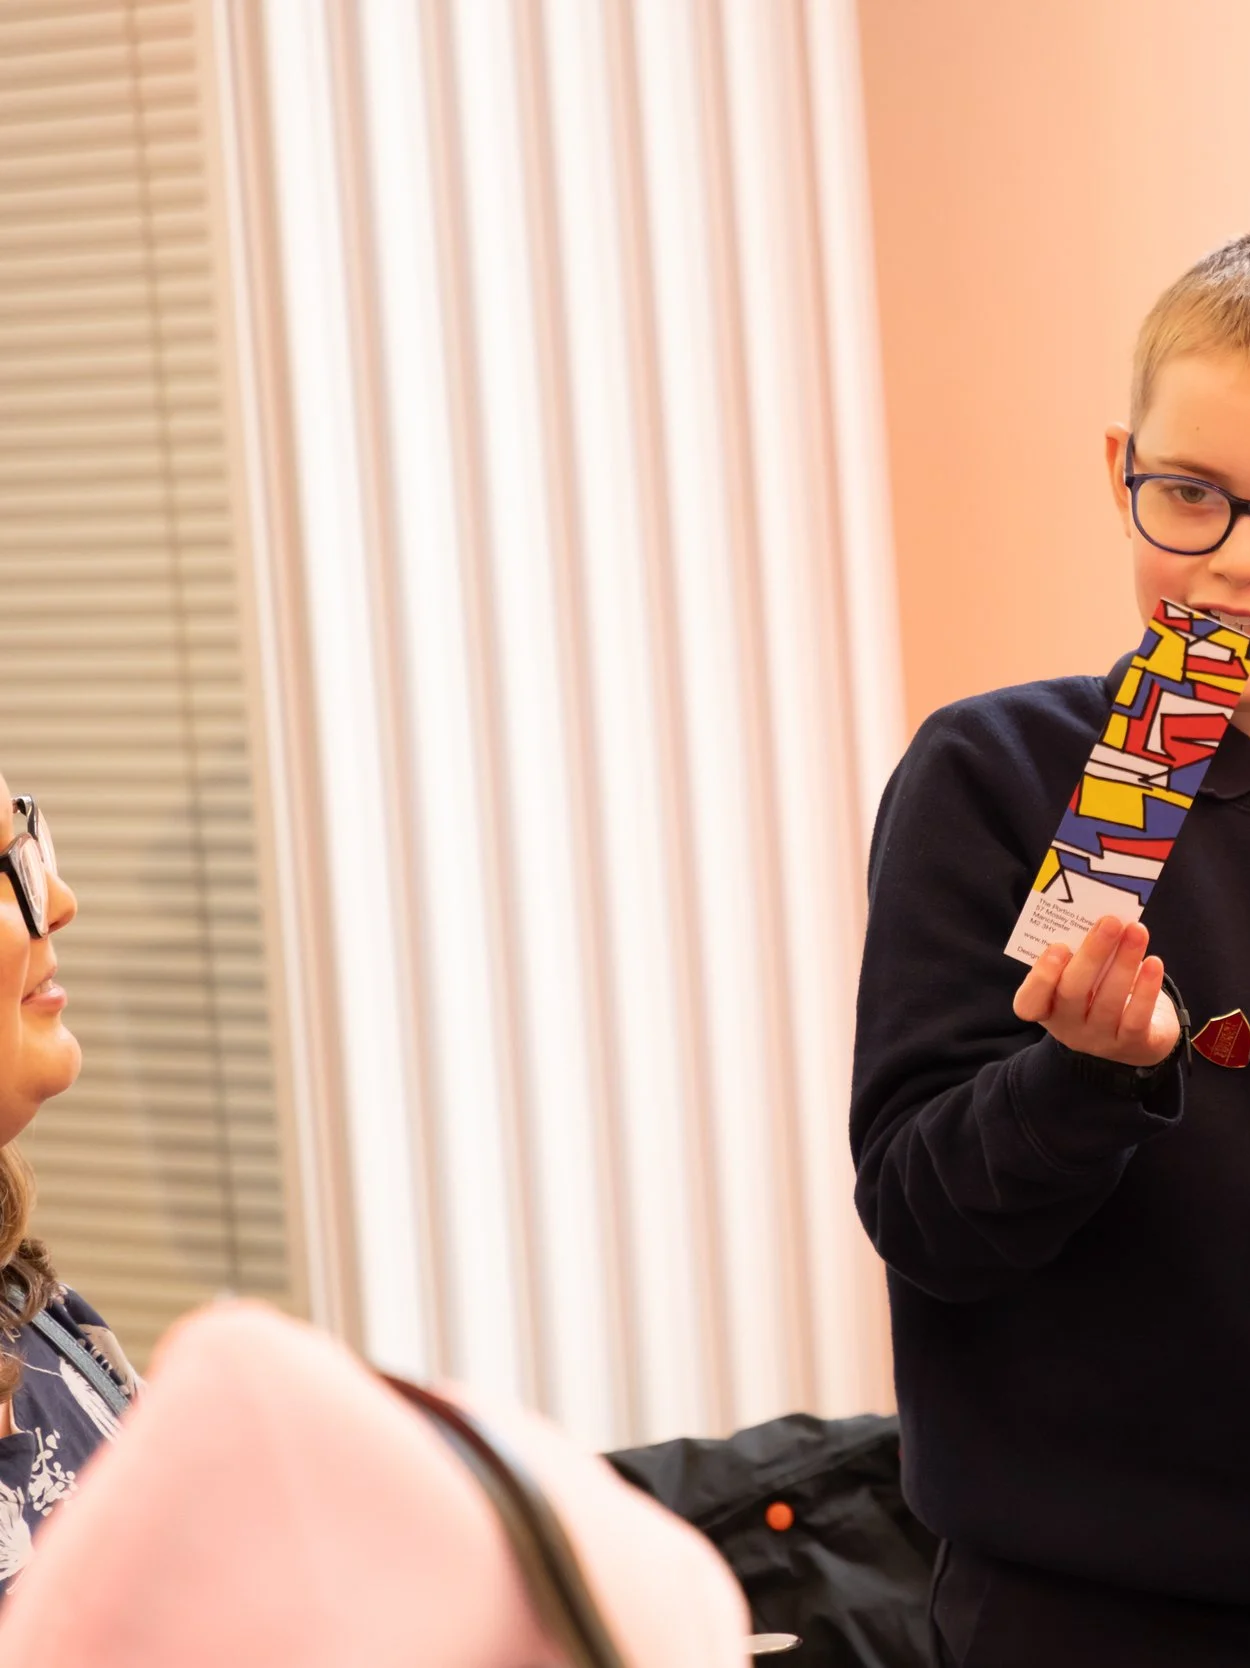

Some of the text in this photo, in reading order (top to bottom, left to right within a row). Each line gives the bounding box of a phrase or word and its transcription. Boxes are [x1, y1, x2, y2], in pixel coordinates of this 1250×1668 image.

[1029, 917, 1040, 926] M2
[1033, 911, 1071, 932] Manchester
[1035, 904, 1090, 932] 57 Mosley Street
[1039, 898, 1095, 927] The Portico Librar
